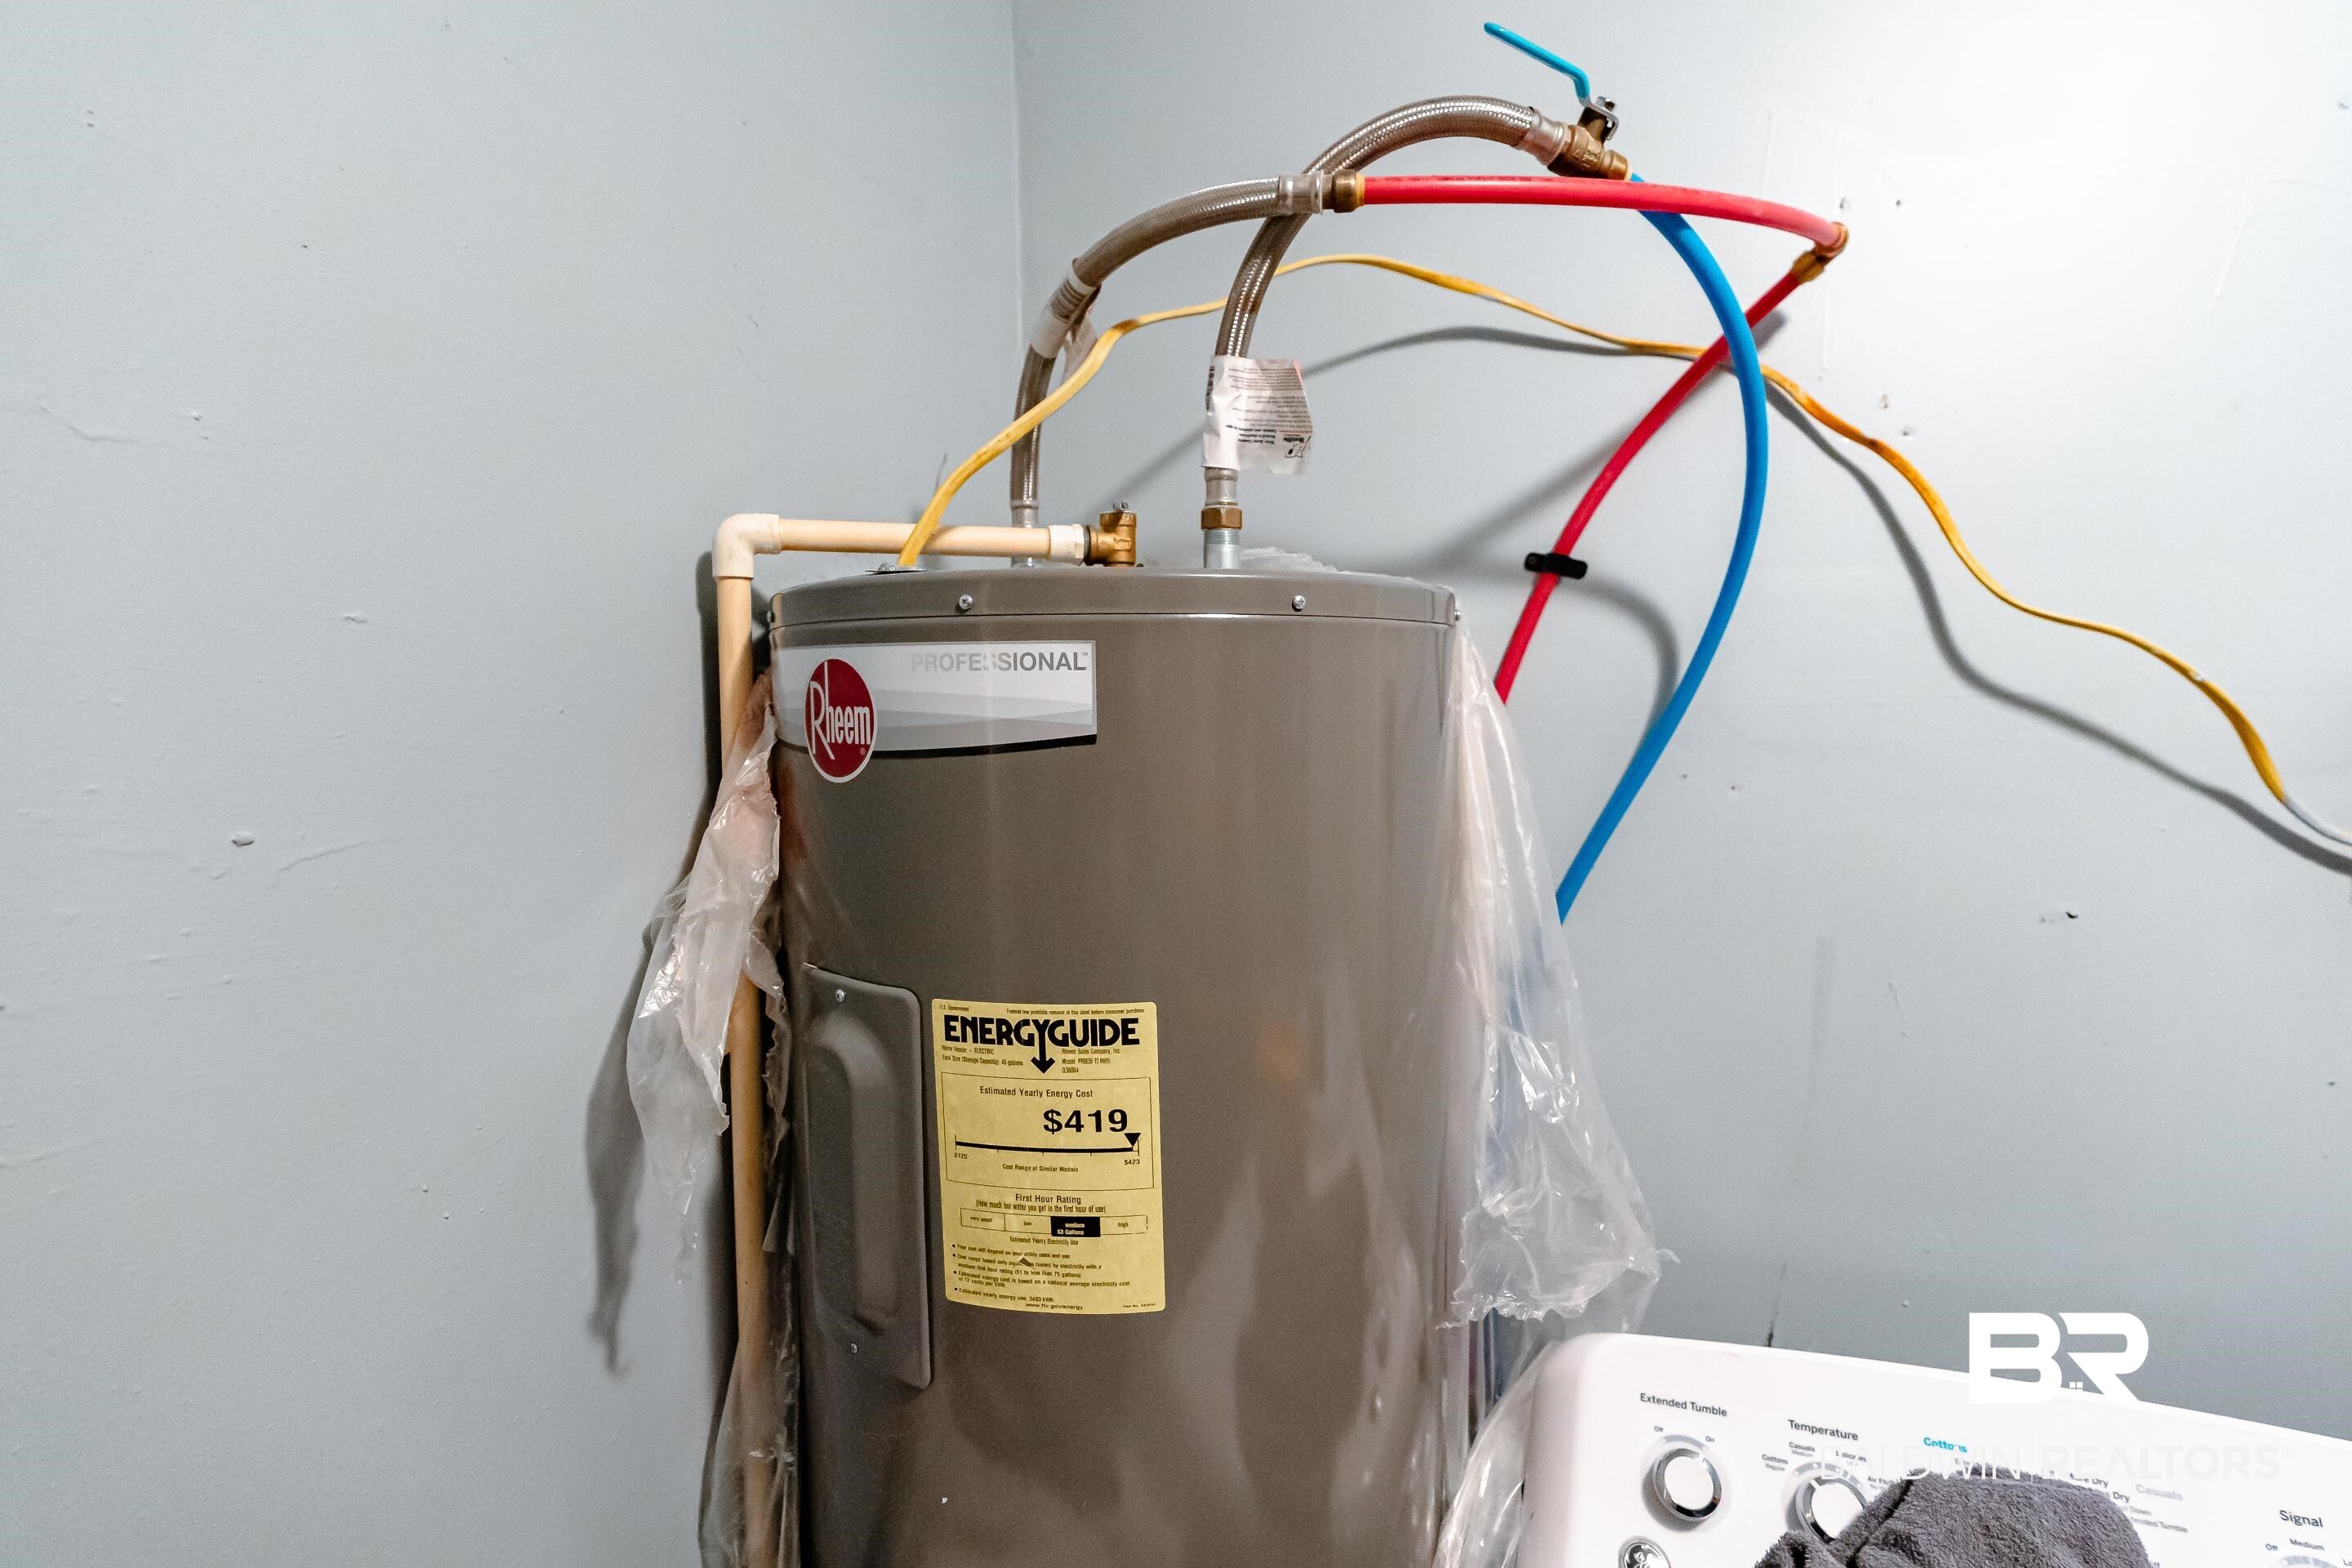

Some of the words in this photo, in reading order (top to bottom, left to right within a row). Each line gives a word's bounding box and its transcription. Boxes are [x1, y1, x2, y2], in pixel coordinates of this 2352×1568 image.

[809, 661, 871, 760] Rheem
[943, 1014, 1140, 1047] ENERGYGUIDE
[973, 1047, 995, 1055] ELECTRIC
[980, 1086, 1016, 1096] Estimated
[1019, 1088, 1043, 1098] Yearly
[1046, 1089, 1073, 1099] Energy
[1076, 1089, 1093, 1098] Cost
[1043, 1108, 1128, 1134] $419
[1016, 1193, 1032, 1202] First
[1035, 1194, 1054, 1204] Hour
[1057, 1196, 1081, 1205] Rating
[976, 1199, 988, 1207] (How
[989, 1200, 1002, 1209] much
[1095, 1205, 1106, 1214] use)
[1032, 1236, 1046, 1245] Yearly
[1047, 1238, 1068, 1246] Electricity
[958, 1271, 980, 1279] Estimated
[959, 1287, 982, 1295] Estimated
[1640, 1392, 1687, 1410] Extended
[1690, 1401, 1727, 1417] Tumble
[1788, 1419, 1859, 1441] Temperature
[1788, 1441, 1815, 1452] Casuals
[1762, 1454, 1788, 1465] Cottons
[2113, 1491, 2130, 1503] Dry
[2136, 1484, 2184, 1501] Casuals
[2130, 1506, 2152, 1516] Down
[2279, 1510, 2323, 1527] Signal
[2159, 1521, 2189, 1533] Tumble
[2265, 1544, 2278, 1552] Off
[2290, 1538, 2324, 1551] Medium
